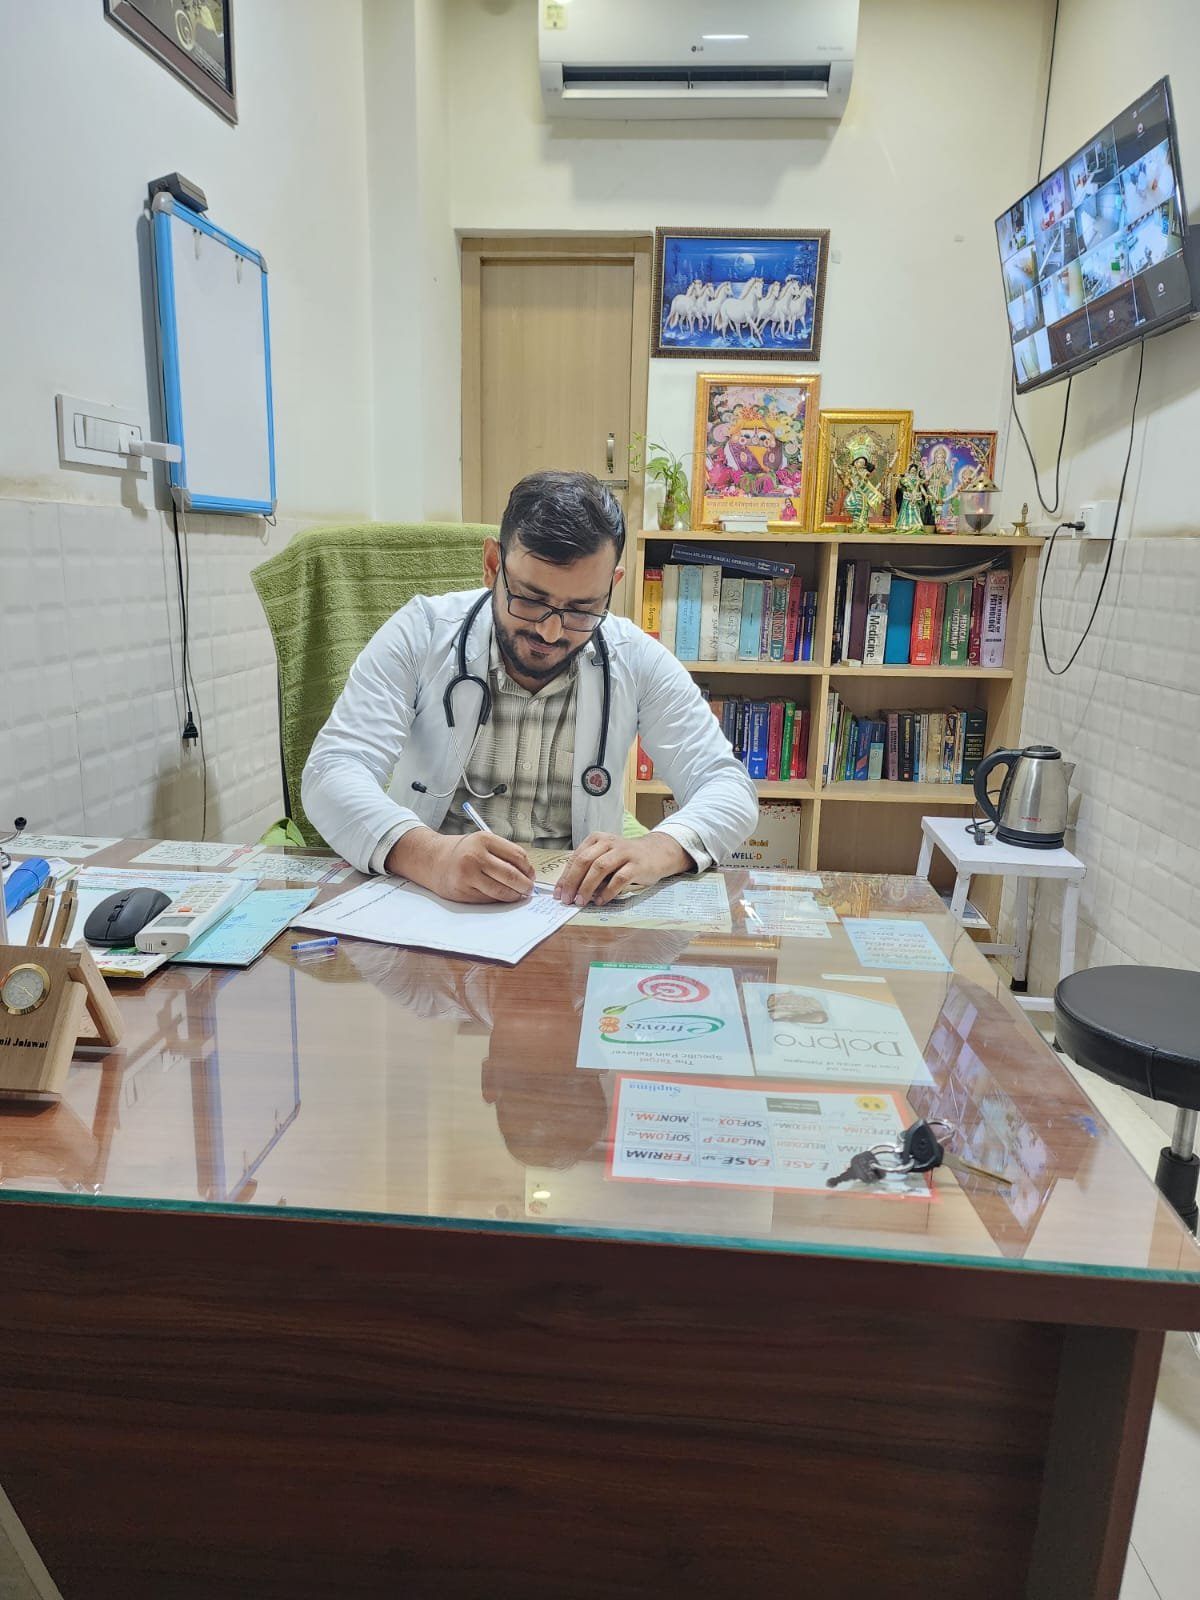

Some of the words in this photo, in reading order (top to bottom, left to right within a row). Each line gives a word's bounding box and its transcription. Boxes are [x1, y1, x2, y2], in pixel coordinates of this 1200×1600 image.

[647, 607, 656, 630] Surgery
[987, 594, 998, 633] PATHOLOGY
[771, 610, 785, 641] SURGERY
[865, 614, 881, 658] Medicine
[950, 608, 961, 649] DICTIONARY
[959, 614, 968, 643] MEDICAL
[761, 630, 769, 651] Surgery
[731, 851, 763, 861] WELL-D
[655, 1051, 679, 1059] Pain
[774, 1032, 904, 1057] Dolpro
[681, 1053, 722, 1061] Specific
[628, 1083, 681, 1094] Suplima
[636, 1113, 689, 1123] MONTMA
[719, 1118, 763, 1128] SOFLOX
[625, 1149, 691, 1162] FERRIMA
